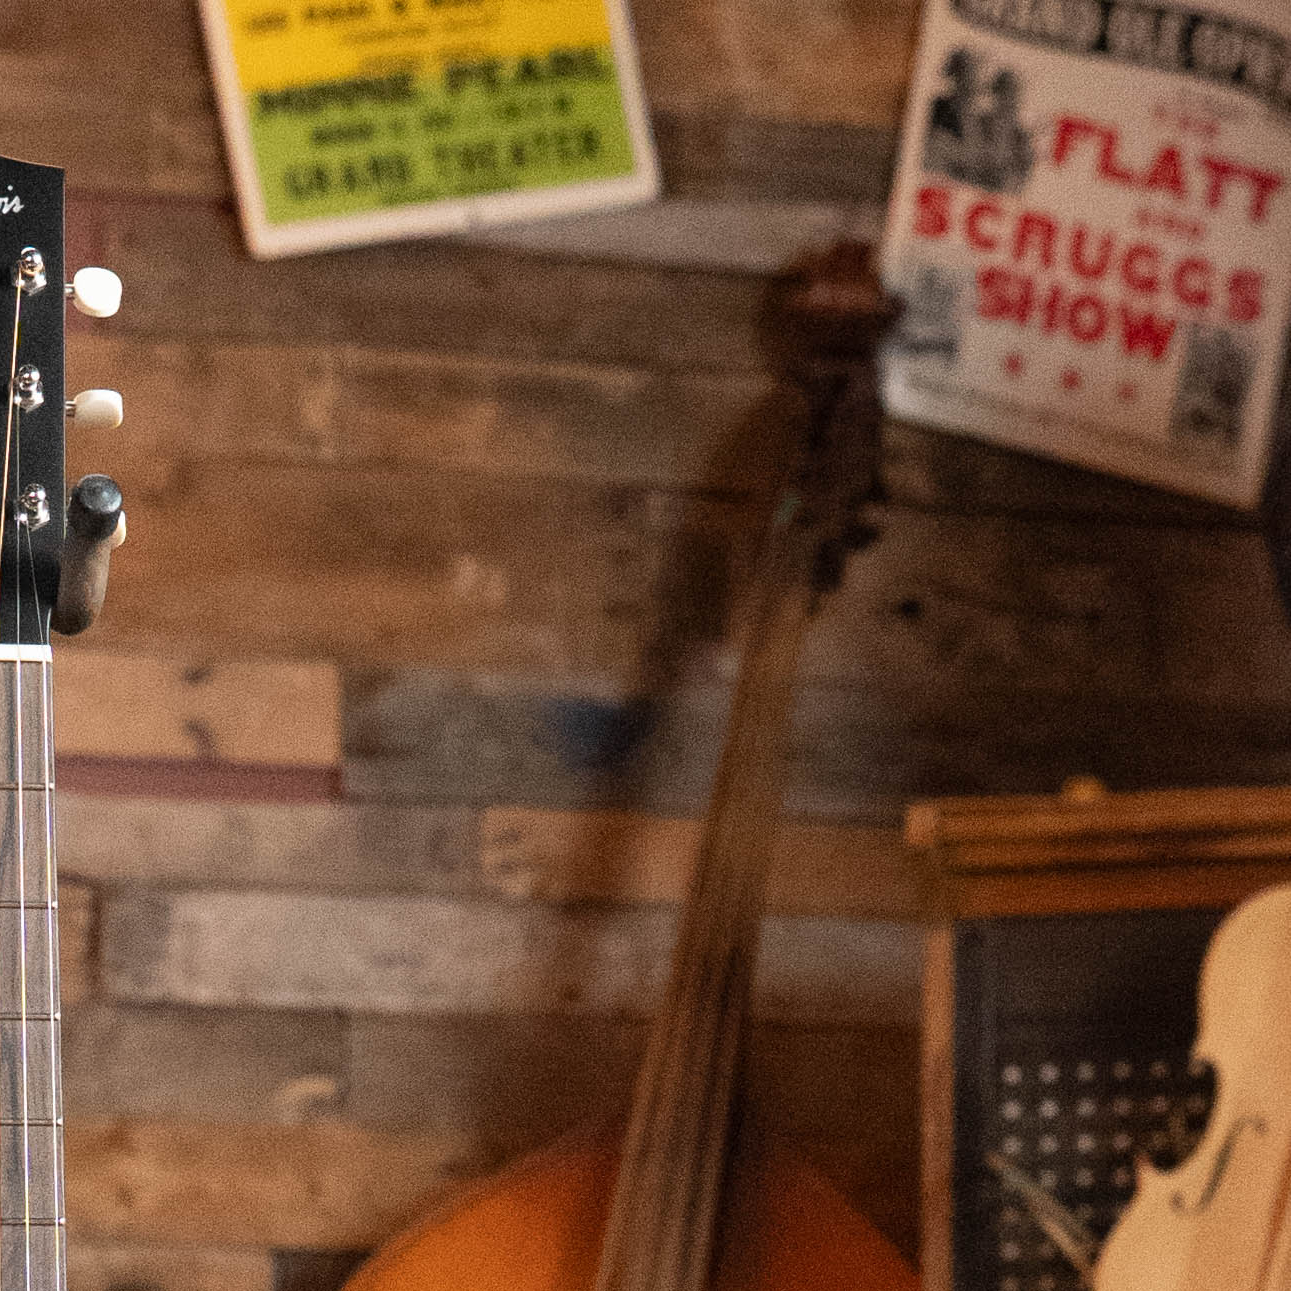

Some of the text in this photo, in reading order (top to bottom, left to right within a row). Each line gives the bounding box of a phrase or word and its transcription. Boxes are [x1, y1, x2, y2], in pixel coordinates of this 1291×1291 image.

[1053, 113, 1282, 223] FLATT
[912, 184, 1264, 323] SCRUGGS
[976, 267, 1178, 361] SHOW
